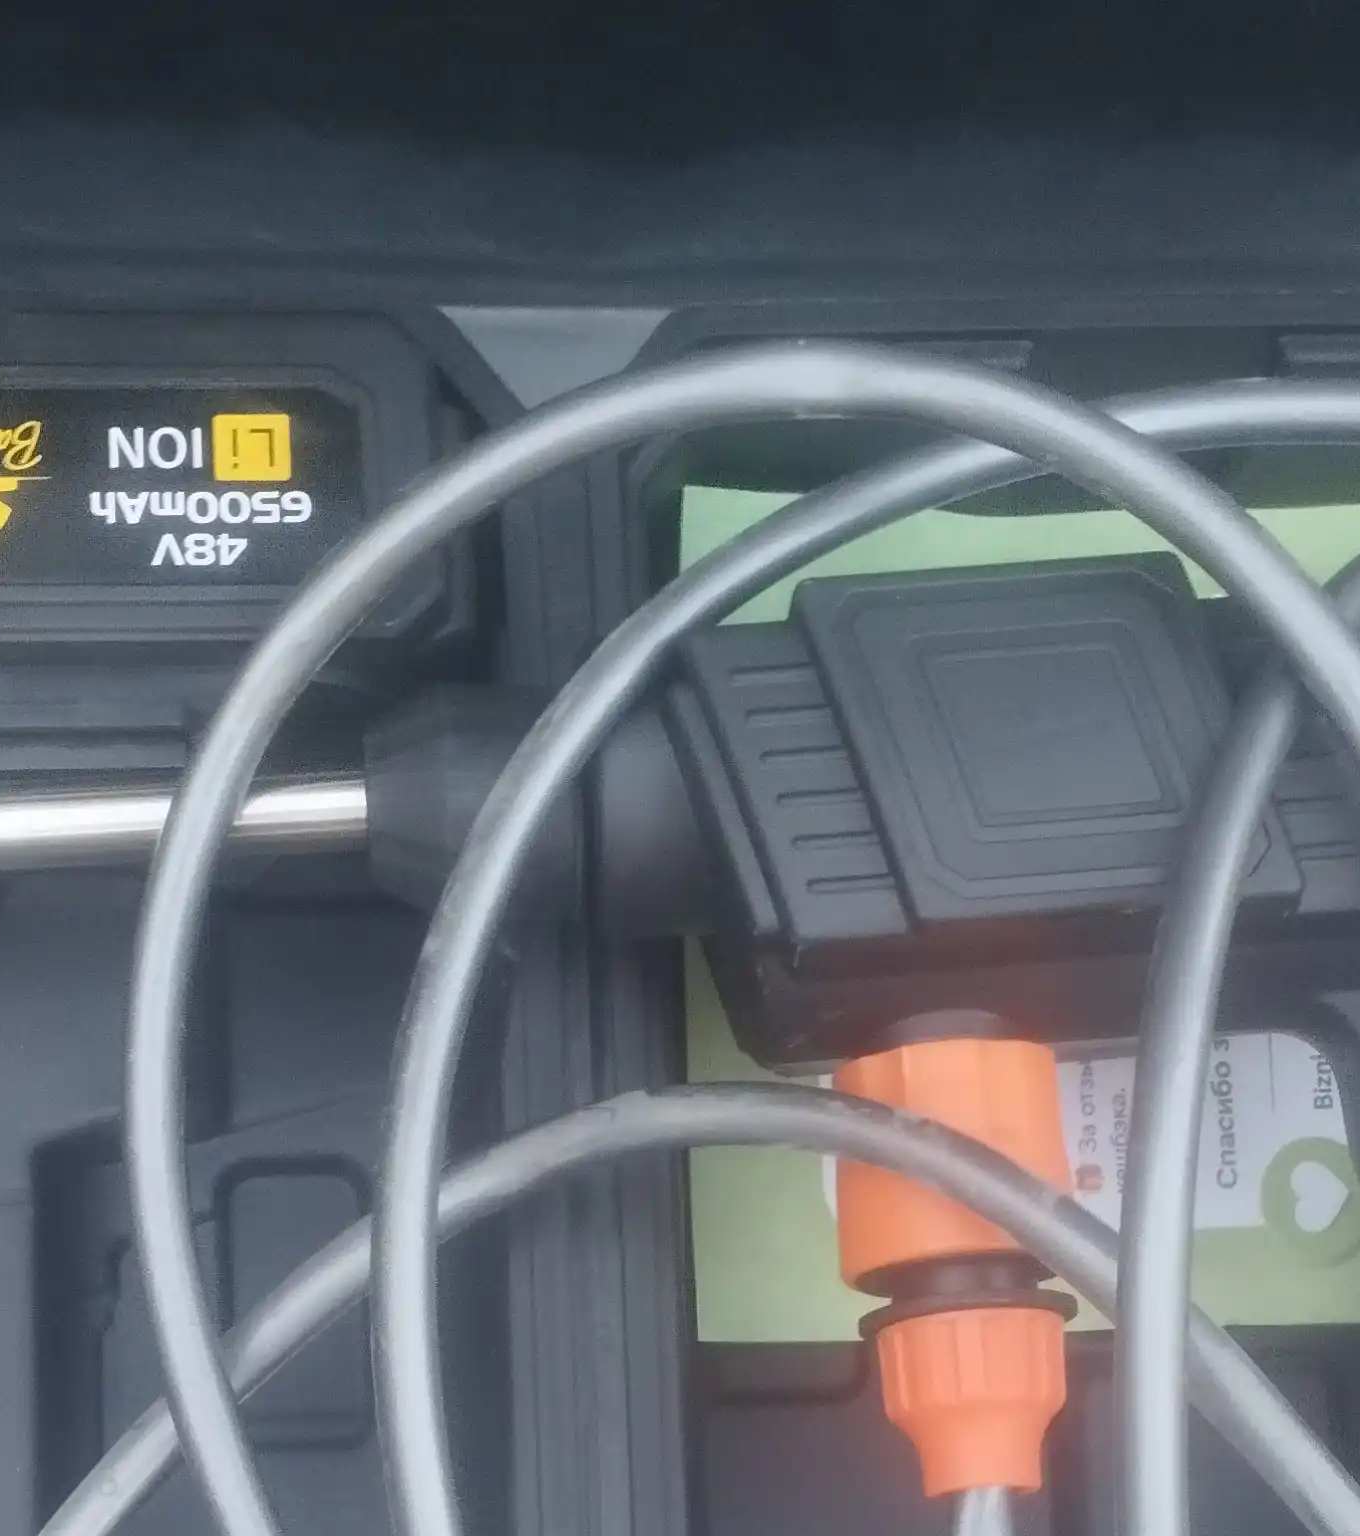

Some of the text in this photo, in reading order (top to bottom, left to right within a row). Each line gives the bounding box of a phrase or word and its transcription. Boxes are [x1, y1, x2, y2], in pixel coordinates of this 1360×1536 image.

[107, 426, 204, 469] ION
[89, 490, 313, 525] 6500mAh
[150, 532, 249, 567] 48V
[1209, 1060, 1238, 1190] Спасибо
